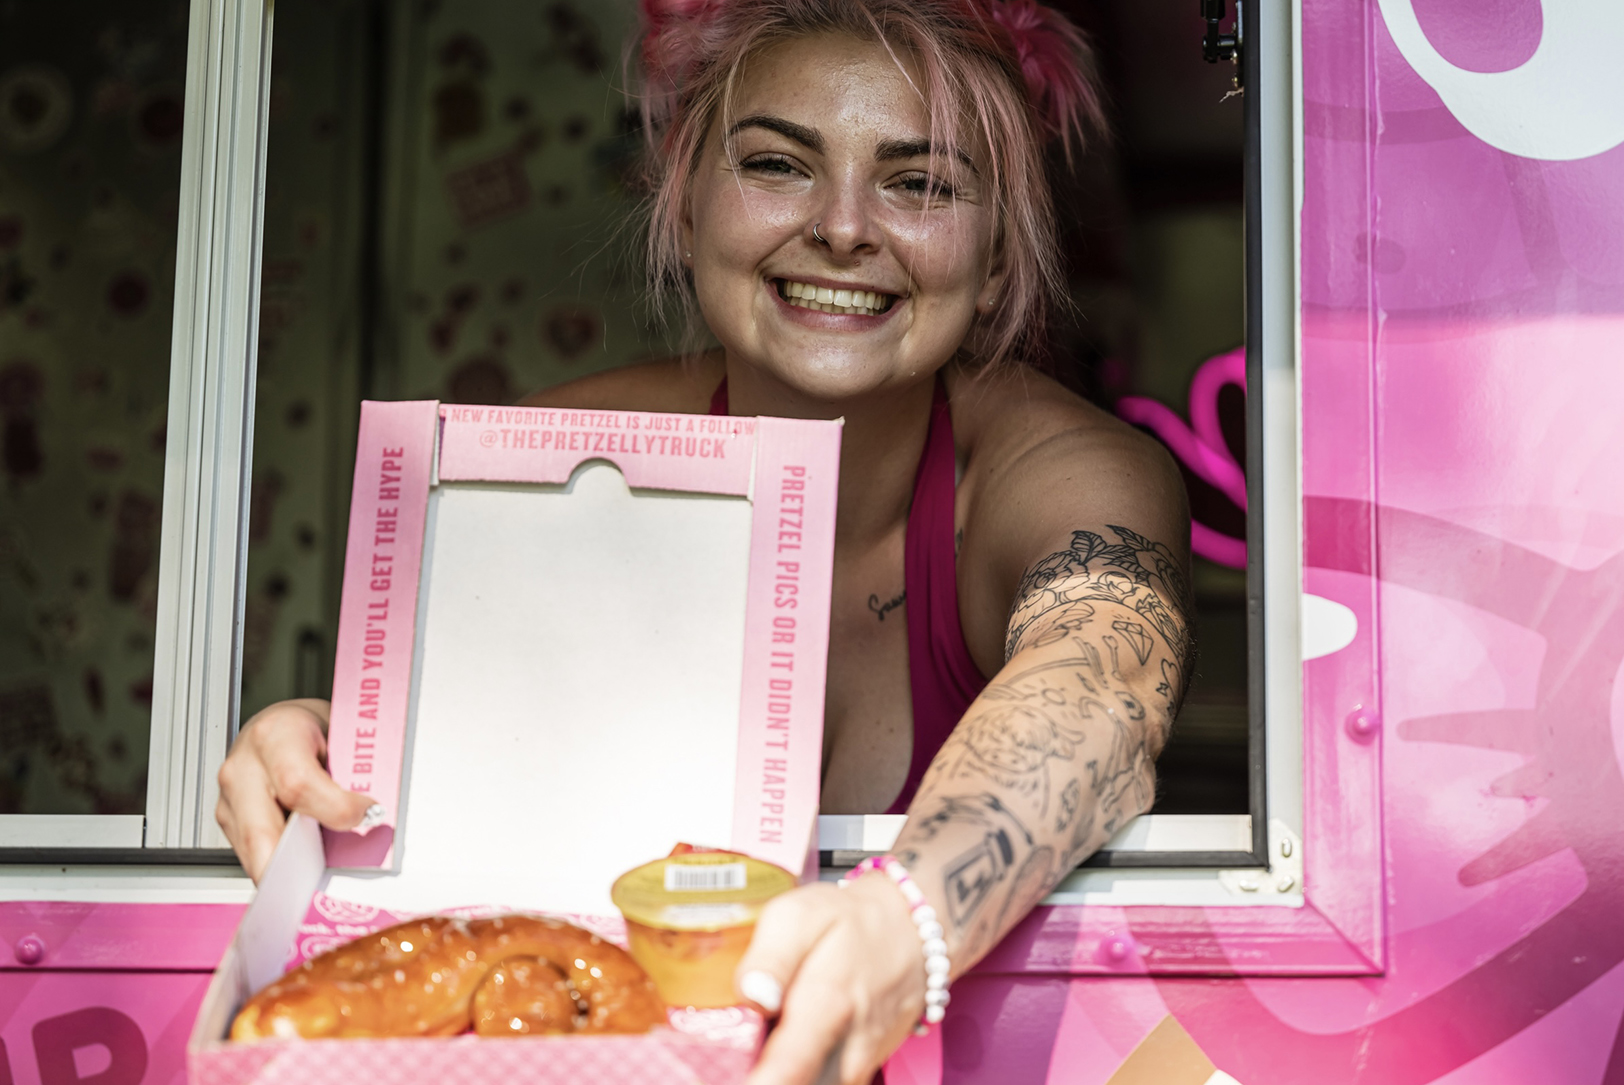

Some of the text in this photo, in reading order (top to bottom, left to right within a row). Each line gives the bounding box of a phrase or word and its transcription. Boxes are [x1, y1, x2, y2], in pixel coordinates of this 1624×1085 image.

[451, 408, 483, 423] NEW
[487, 410, 556, 426] FAVORITE
[560, 412, 621, 429] PRETZEL
[626, 415, 640, 430] IS
[644, 416, 682, 432] JUST
[686, 418, 694, 432] A
[700, 419, 757, 436] FOLLOW
[479, 429, 726, 459] @THEPRETZELLYTRUCK
[378, 446, 404, 500] HYPE
[374, 507, 398, 546] THE
[370, 553, 393, 591] GET
[362, 598, 389, 671] YOU'LL
[759, 465, 806, 844] PRETZEL PICS OR IT DIDN'T HAPPEN
[358, 678, 381, 720] AND
[352, 727, 376, 774] BITE
